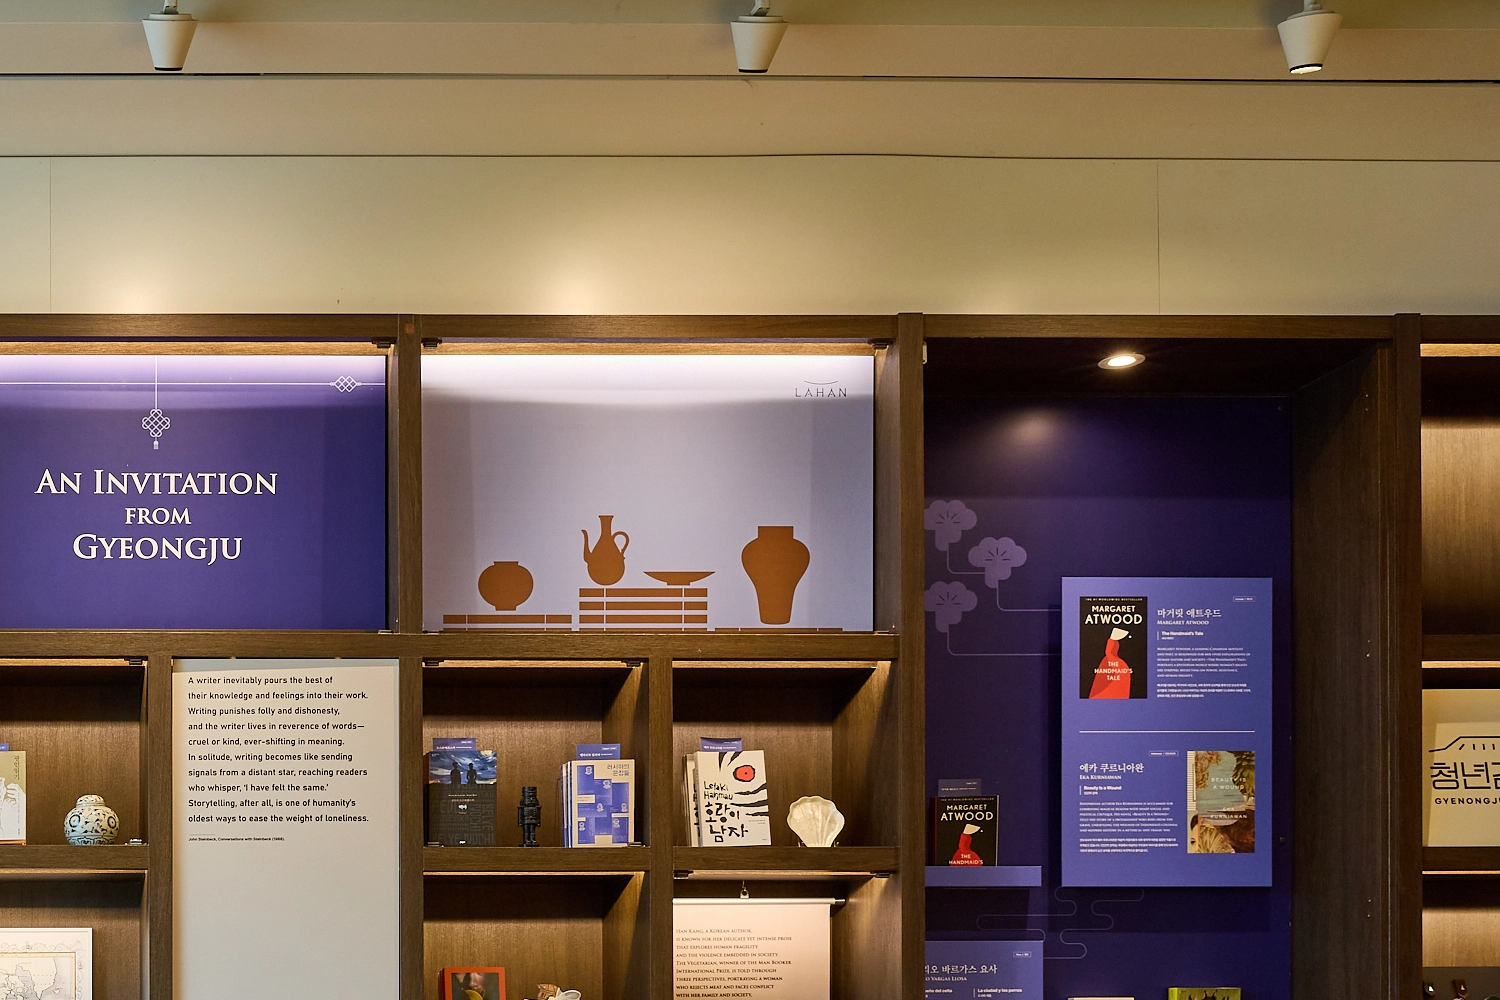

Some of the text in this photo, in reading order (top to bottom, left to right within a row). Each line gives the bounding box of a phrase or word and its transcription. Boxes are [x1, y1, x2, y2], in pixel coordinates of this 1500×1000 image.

[795, 388, 847, 398] LAHAN
[34, 468, 278, 494] AN INVITATION
[125, 508, 192, 524] FROM
[73, 534, 242, 566] GYEONGJU
[1157, 608, 1222, 618] 마거릿 애트우드
[1084, 614, 1142, 624] ATWOOD
[196, 676, 221, 684] writer
[223, 676, 262, 686] inevitably
[264, 678, 288, 686] pours
[290, 676, 303, 684] the
[305, 676, 323, 684] best
[324, 676, 333, 684] of
[188, 692, 207, 700] their
[209, 692, 253, 701] knowledge
[272, 691, 304, 701] feelings
[306, 691, 322, 699] into
[324, 691, 344, 699] their
[345, 691, 368, 699] work.
[1079, 762, 1144, 773] 에카 쿠르니아완
[705, 801, 739, 823] 호랑이
[940, 811, 994, 821] ATWOOD
[709, 824, 748, 842] 남자
[942, 964, 978, 974] 바르가스
[980, 964, 998, 974] 요사
